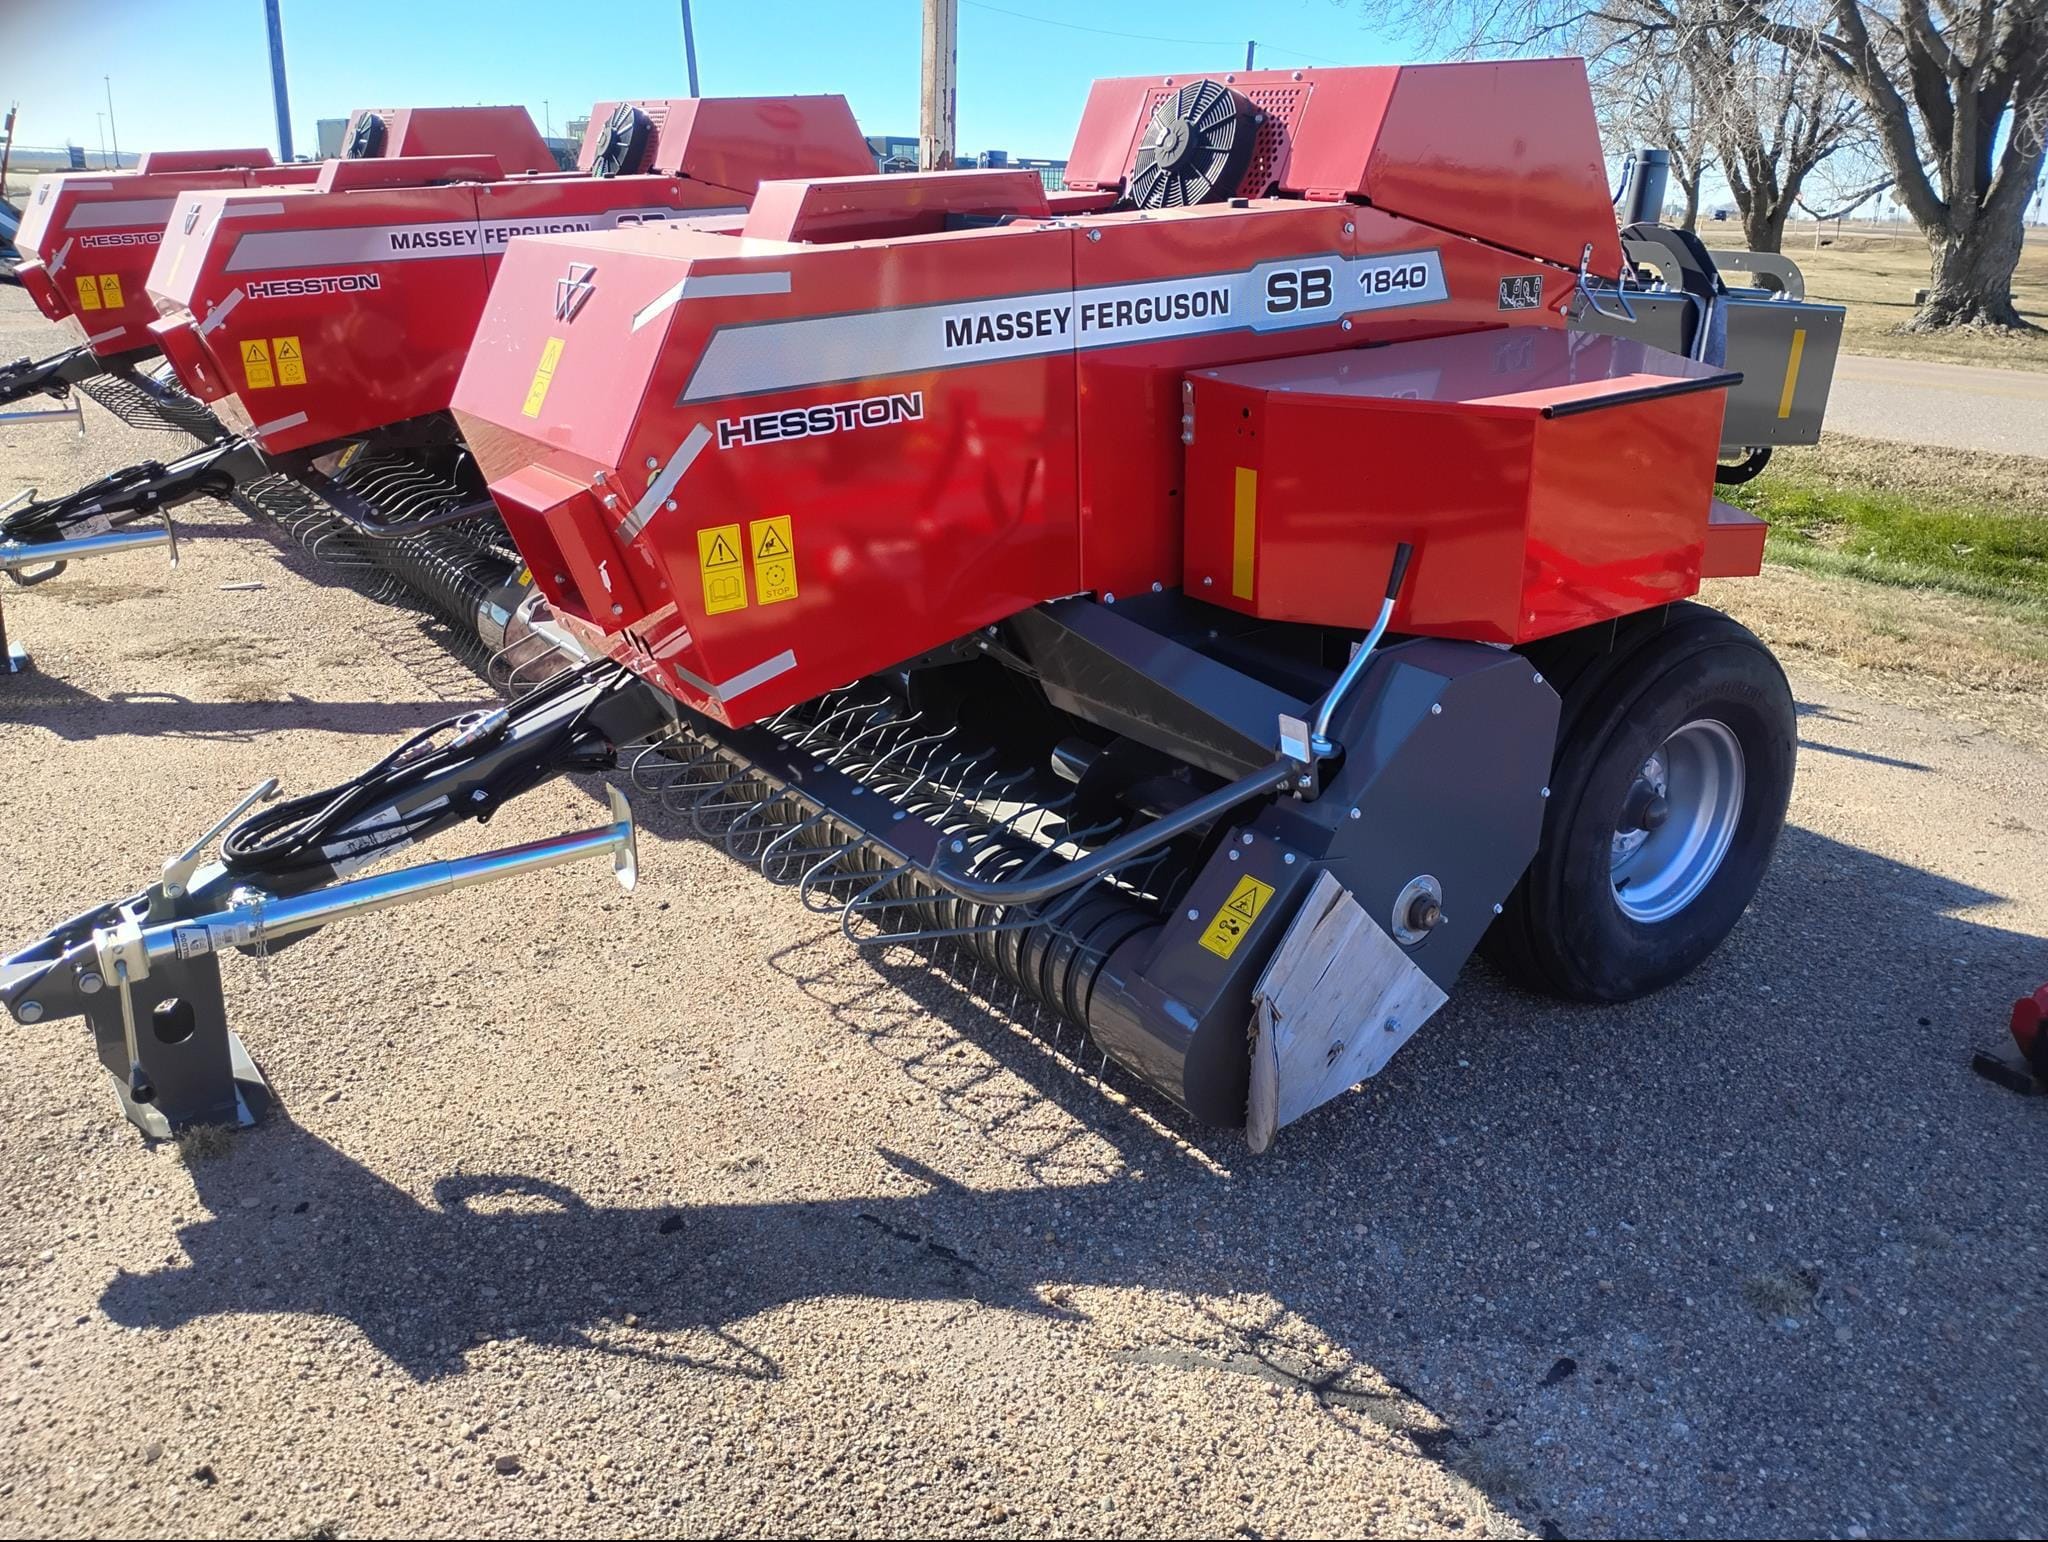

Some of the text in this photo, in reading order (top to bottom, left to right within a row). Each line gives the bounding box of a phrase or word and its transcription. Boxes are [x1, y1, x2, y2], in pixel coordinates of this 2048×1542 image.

[81, 232, 165, 247] HESSTO
[390, 229, 478, 250] MASSEY
[248, 274, 379, 298] HESSTON
[945, 265, 1427, 348] MASSEY FERGUSON SB 1840
[718, 393, 922, 448] HESSTON
[766, 586, 790, 599] STOP
